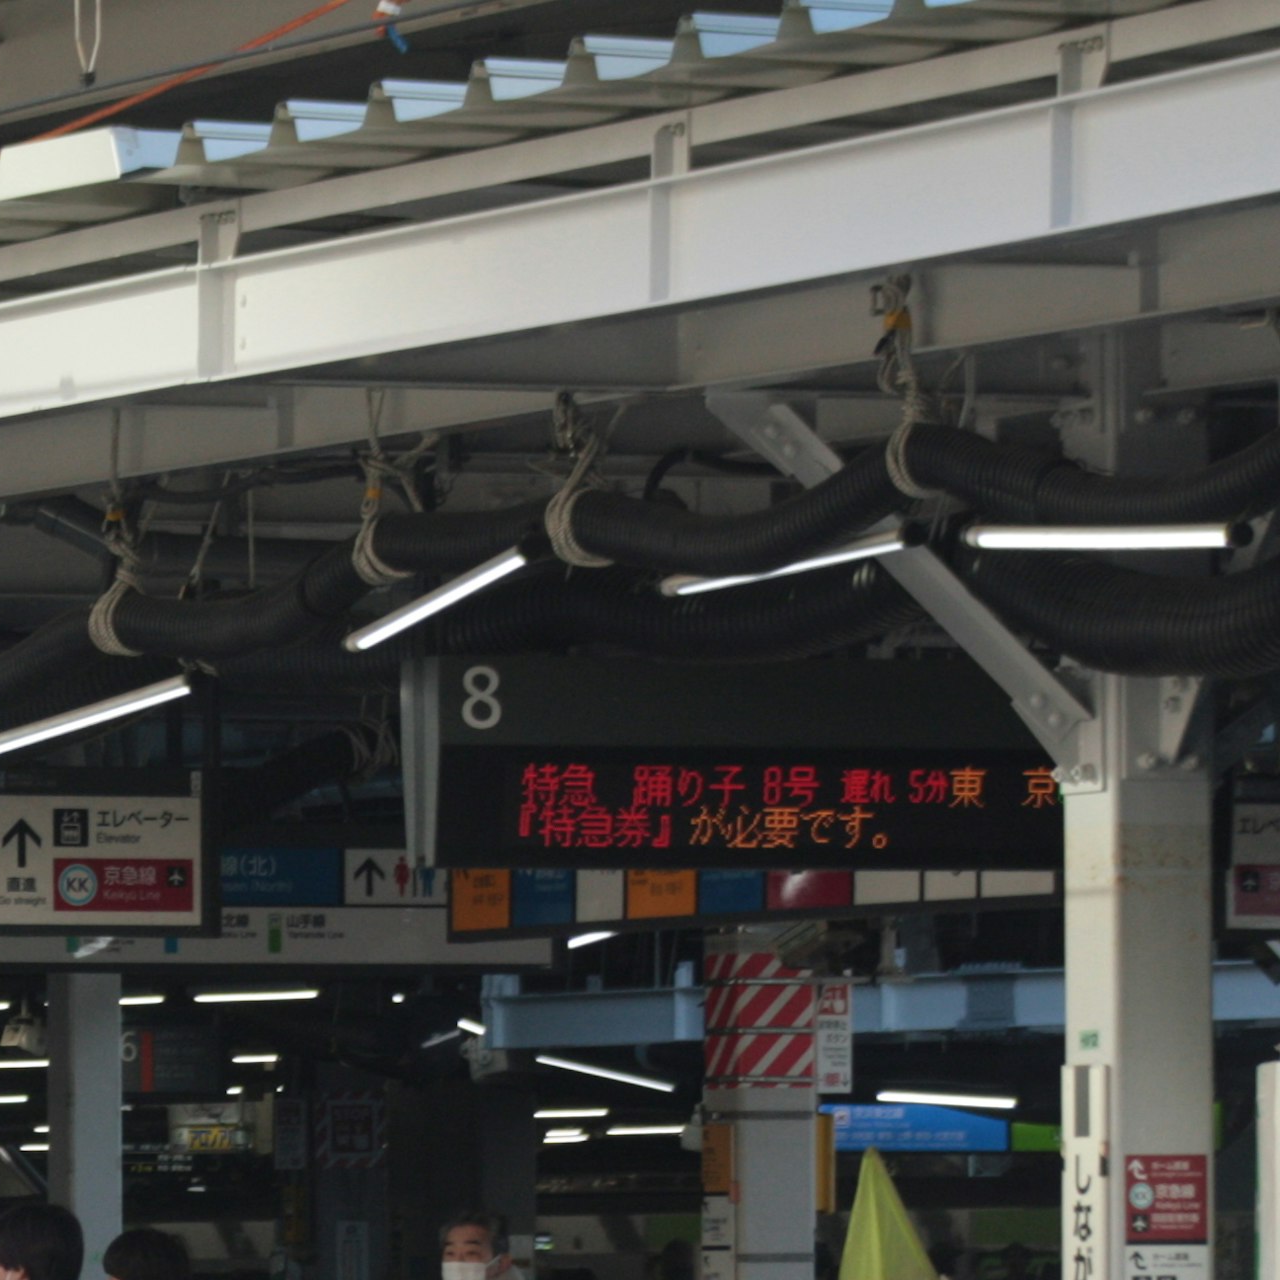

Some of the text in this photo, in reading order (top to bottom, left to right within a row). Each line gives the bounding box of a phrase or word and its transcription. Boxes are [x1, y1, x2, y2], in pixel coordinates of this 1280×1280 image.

[461, 664, 503, 730] 8
[521, 763, 596, 804] 特急
[632, 765, 746, 806] 踊り子
[762, 765, 821, 804] 8号
[842, 767, 895, 804] 遅れ
[908, 767, 949, 803] 5分
[95, 810, 190, 828] エレベーター
[96, 832, 142, 845] Elevator
[103, 865, 158, 886] 京急線
[7, 877, 37, 893] 直進
[66, 877, 89, 893] KK
[13, 896, 47, 907] straight
[286, 914, 326, 928] 山手線
